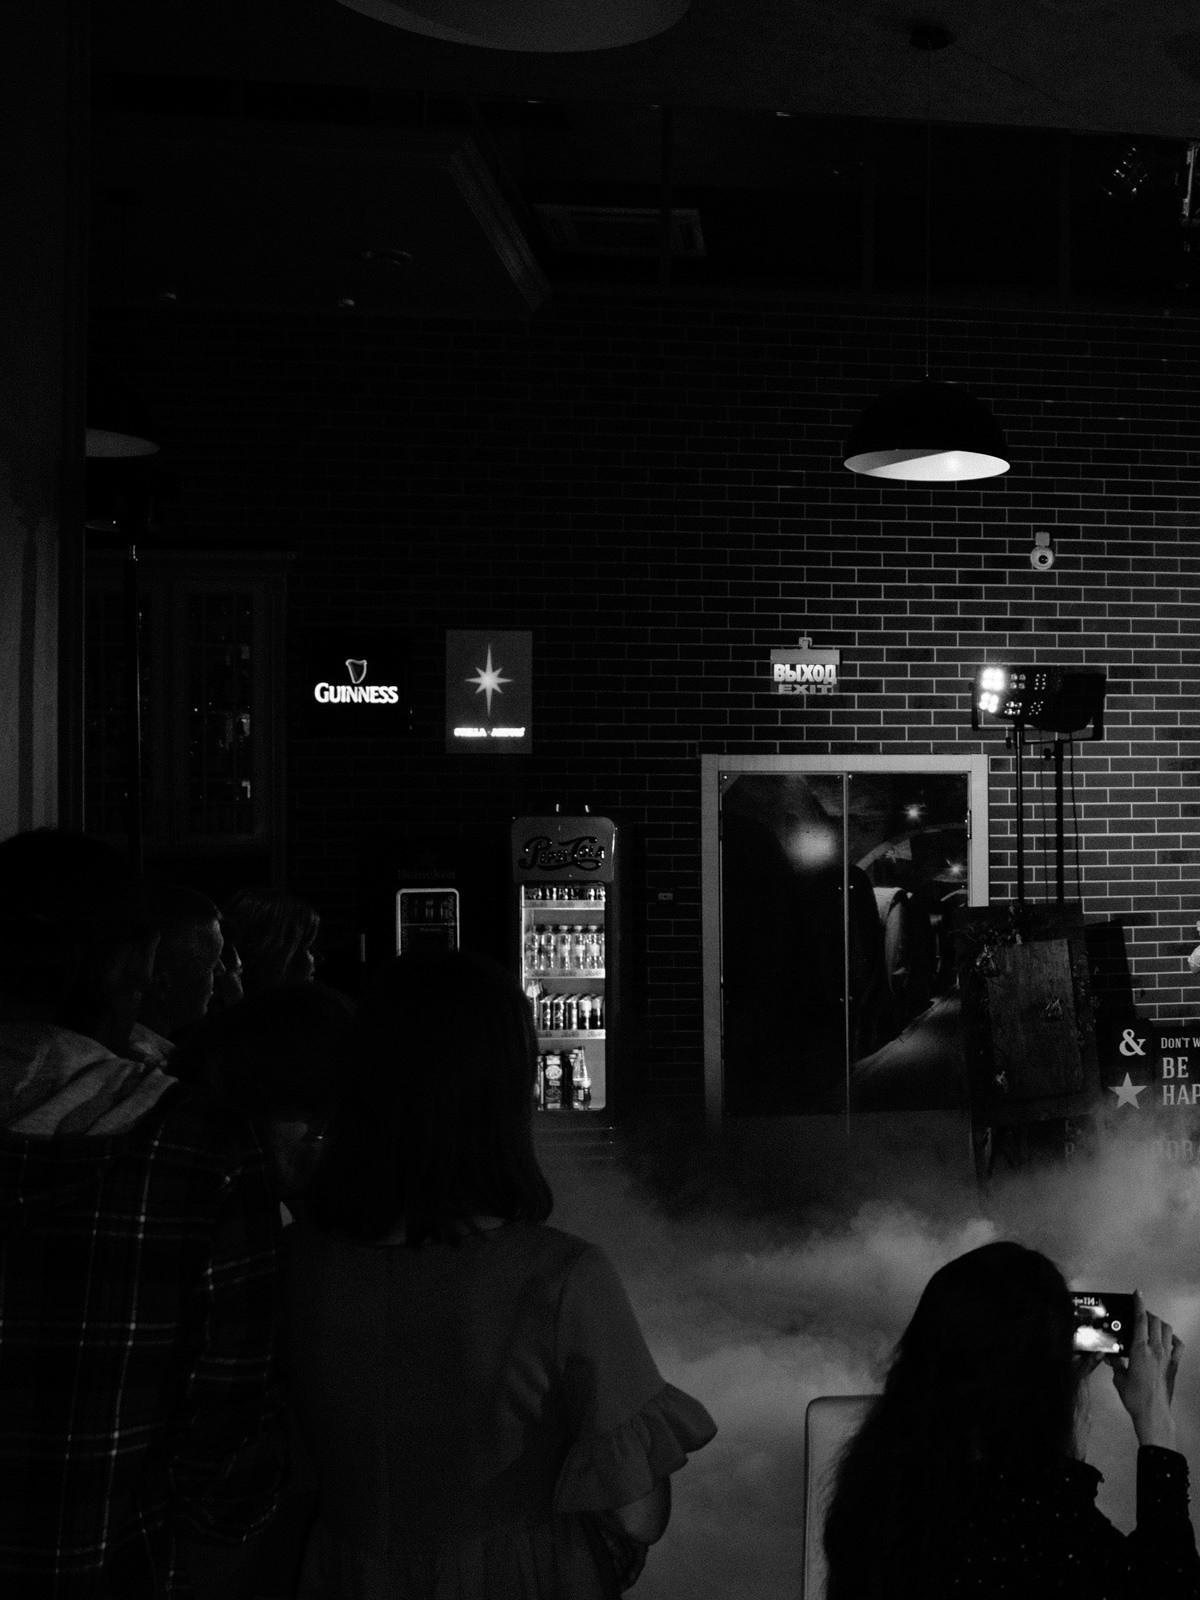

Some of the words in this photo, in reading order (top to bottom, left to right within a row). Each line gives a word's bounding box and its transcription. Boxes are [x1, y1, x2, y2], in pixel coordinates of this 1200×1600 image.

[774, 664, 837, 684] ВЫХОД
[314, 682, 399, 704] GUINNESS
[779, 684, 833, 695] EXIT
[1118, 1028, 1147, 1057] &
[1160, 1036, 1190, 1049] DON'T
[1162, 1057, 1189, 1079] BE
